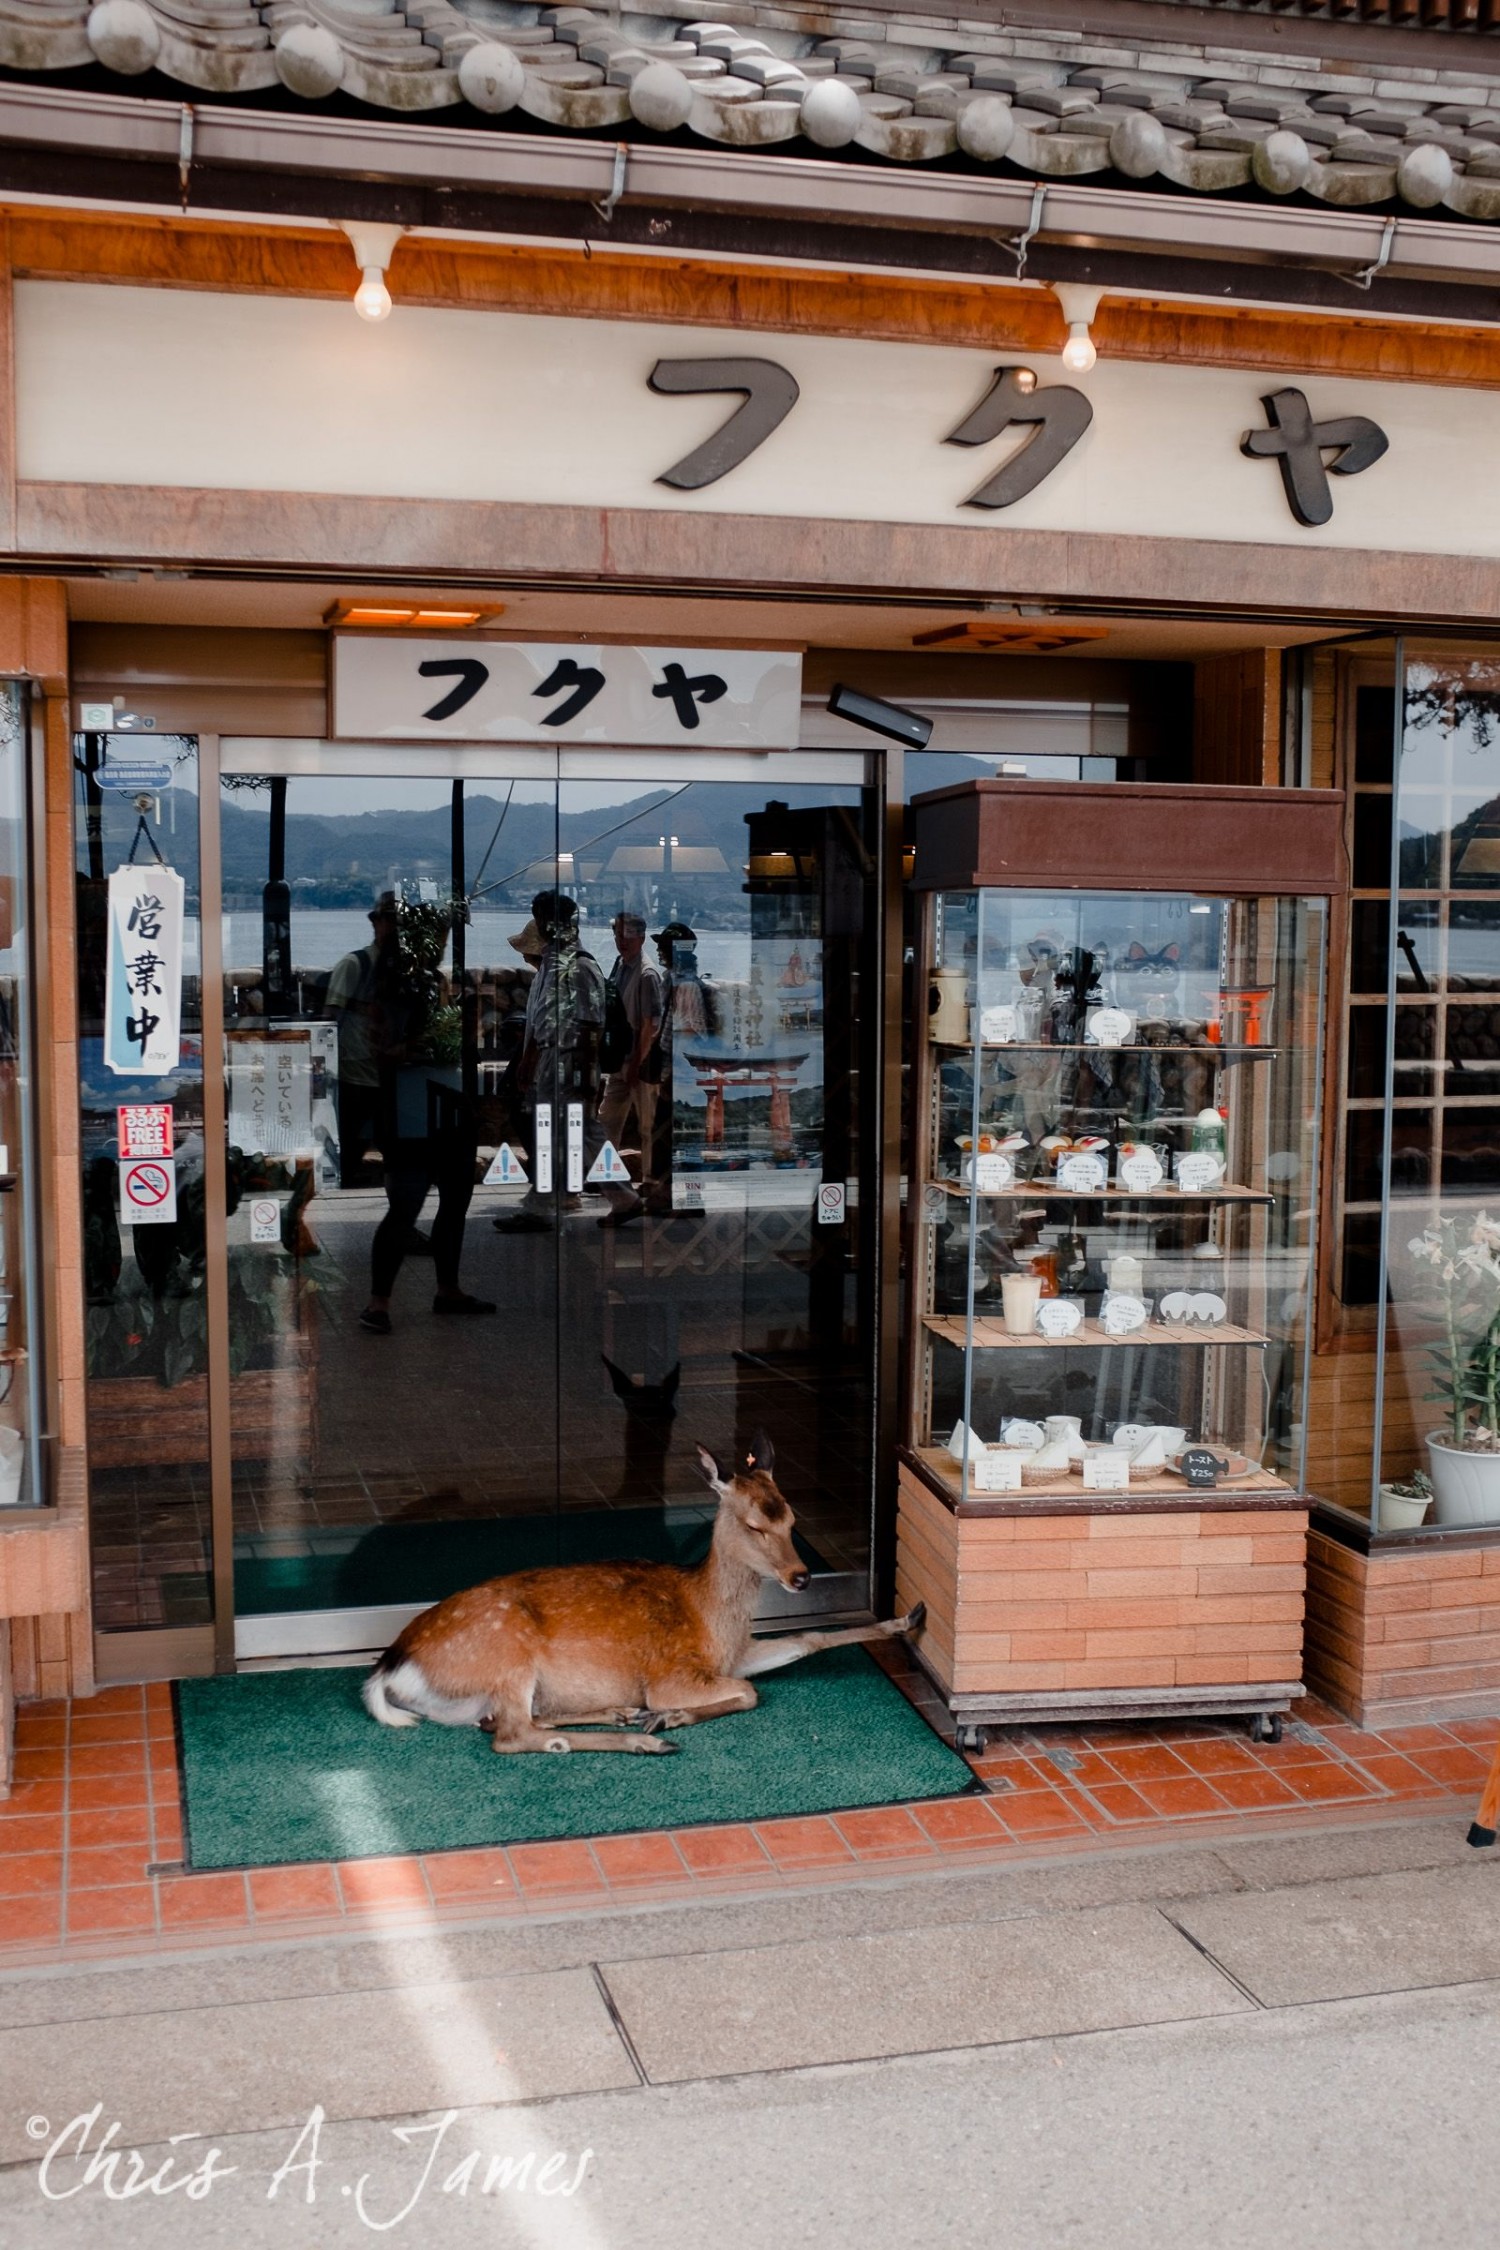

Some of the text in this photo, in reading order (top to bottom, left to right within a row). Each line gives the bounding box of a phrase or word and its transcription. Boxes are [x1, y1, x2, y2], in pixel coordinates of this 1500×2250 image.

[646, 356, 1390, 528] フクヤ
[418, 658, 728, 730] フクヤ
[125, 893, 166, 1058] 営業中
[277, 1054, 293, 1129] 空いている
[125, 1107, 166, 1127] るるぶ
[127, 1126, 164, 1145] FREE
[492, 1164, 518, 1174] 注意
[595, 1163, 621, 1172] 注意
[1188, 1455, 1213, 1465] トースト
[1190, 1468, 1214, 1478] ¥250
